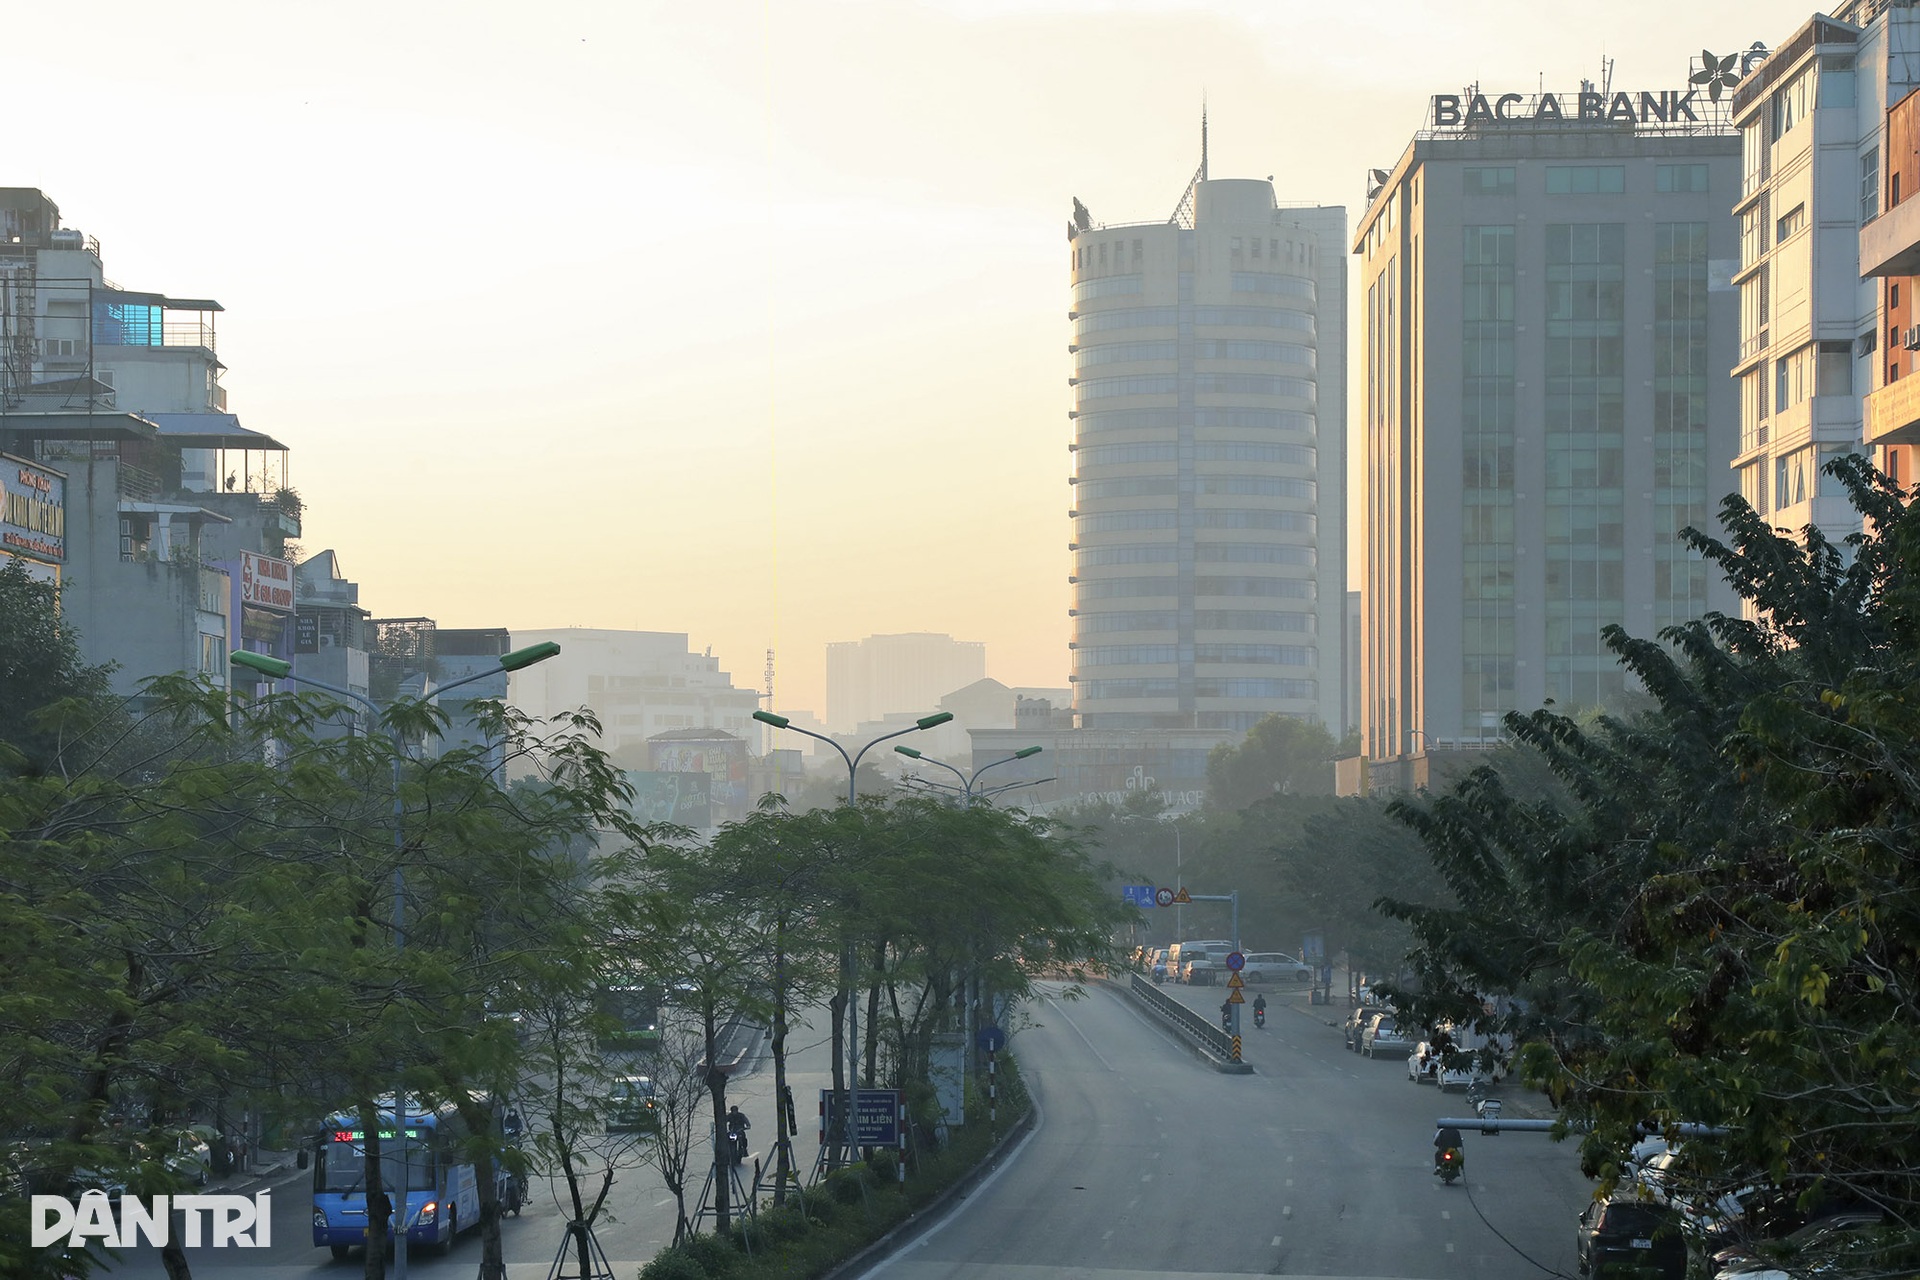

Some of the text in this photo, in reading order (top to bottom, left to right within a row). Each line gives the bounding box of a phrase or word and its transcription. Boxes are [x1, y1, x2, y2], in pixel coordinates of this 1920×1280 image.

[1435, 90, 1699, 126] BAC A BANK
[257, 559, 288, 581] NHA KHOA
[254, 578, 291, 607] LÊ GIA GROUP
[870, 1113, 893, 1124] LIÊN
